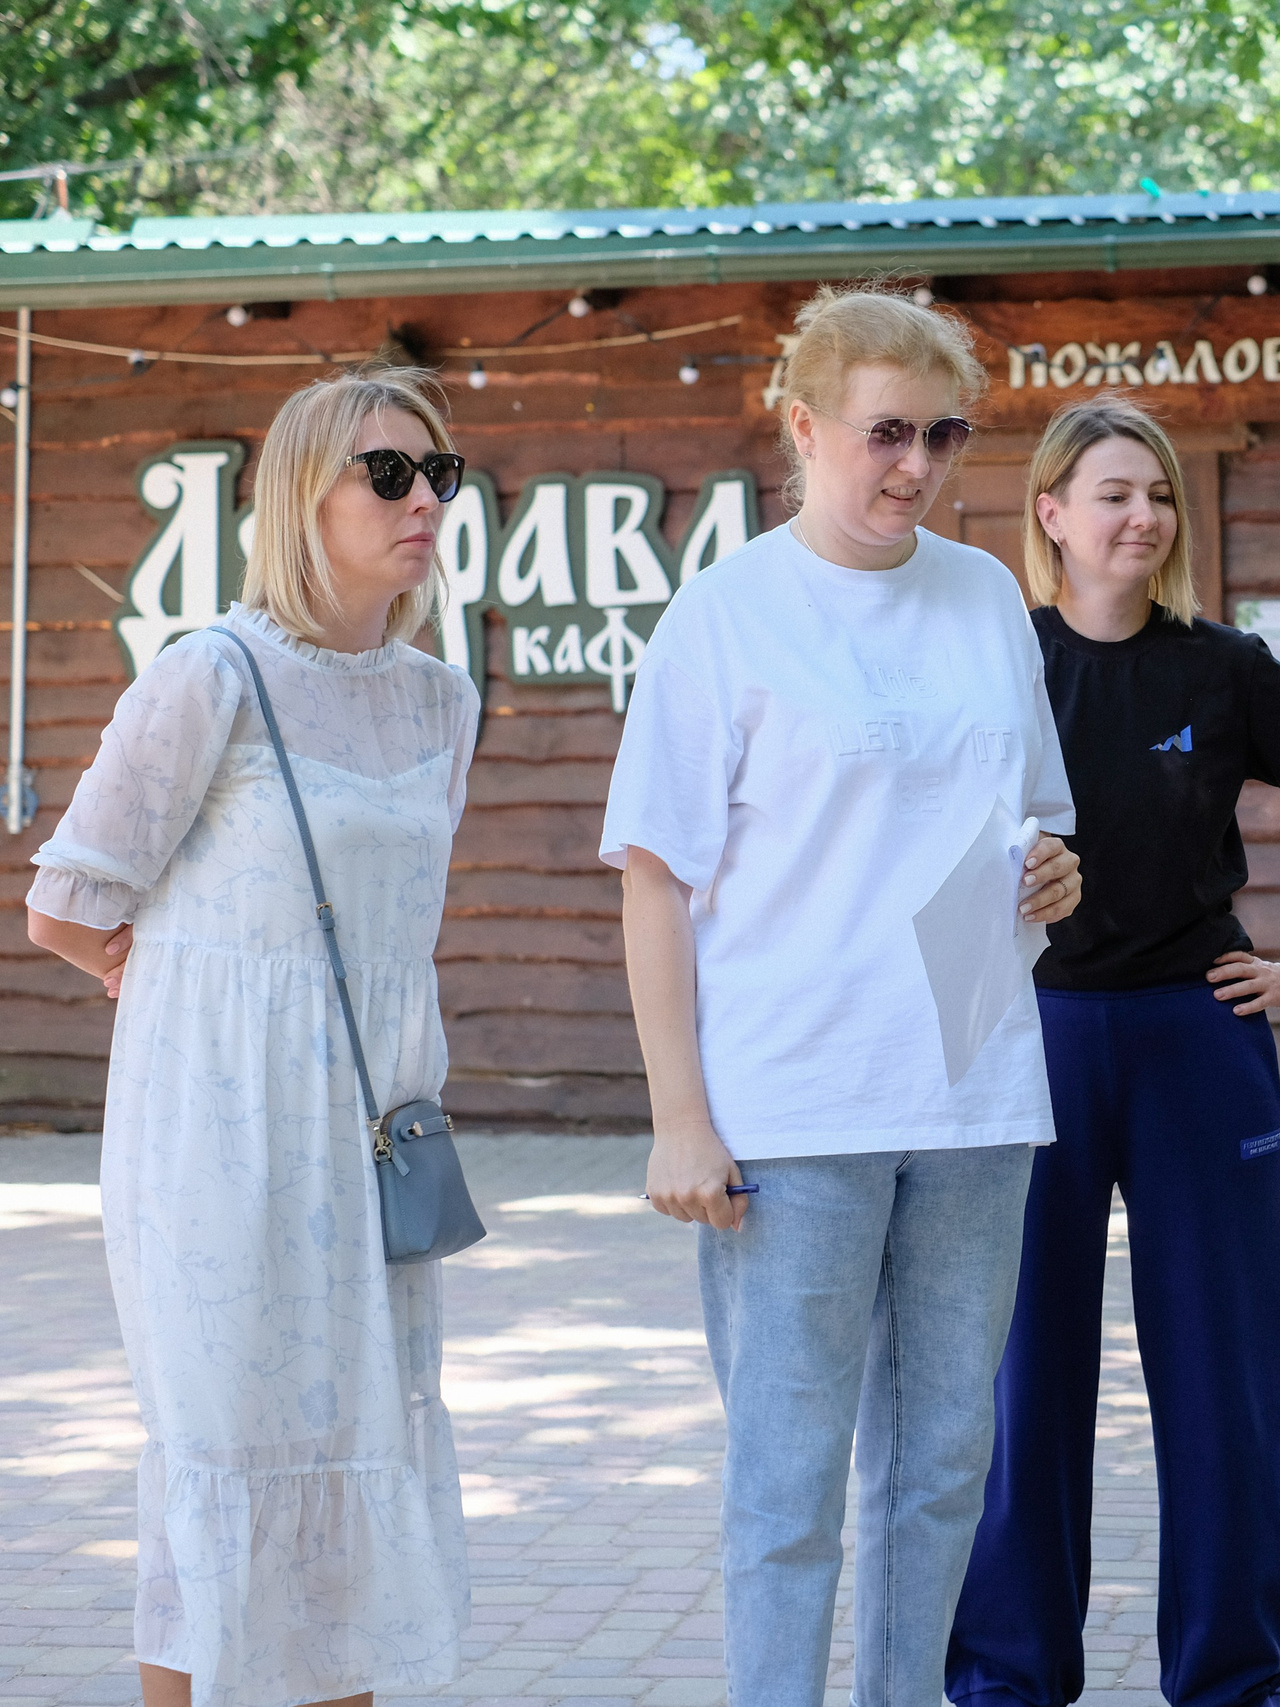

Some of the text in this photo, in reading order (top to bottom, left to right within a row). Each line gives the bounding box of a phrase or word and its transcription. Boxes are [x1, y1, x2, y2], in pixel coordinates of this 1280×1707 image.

[118, 452, 747, 677] Драва
[513, 607, 646, 713] каф
[829, 717, 1012, 763] LET IT
[896, 776, 943, 815] BE
